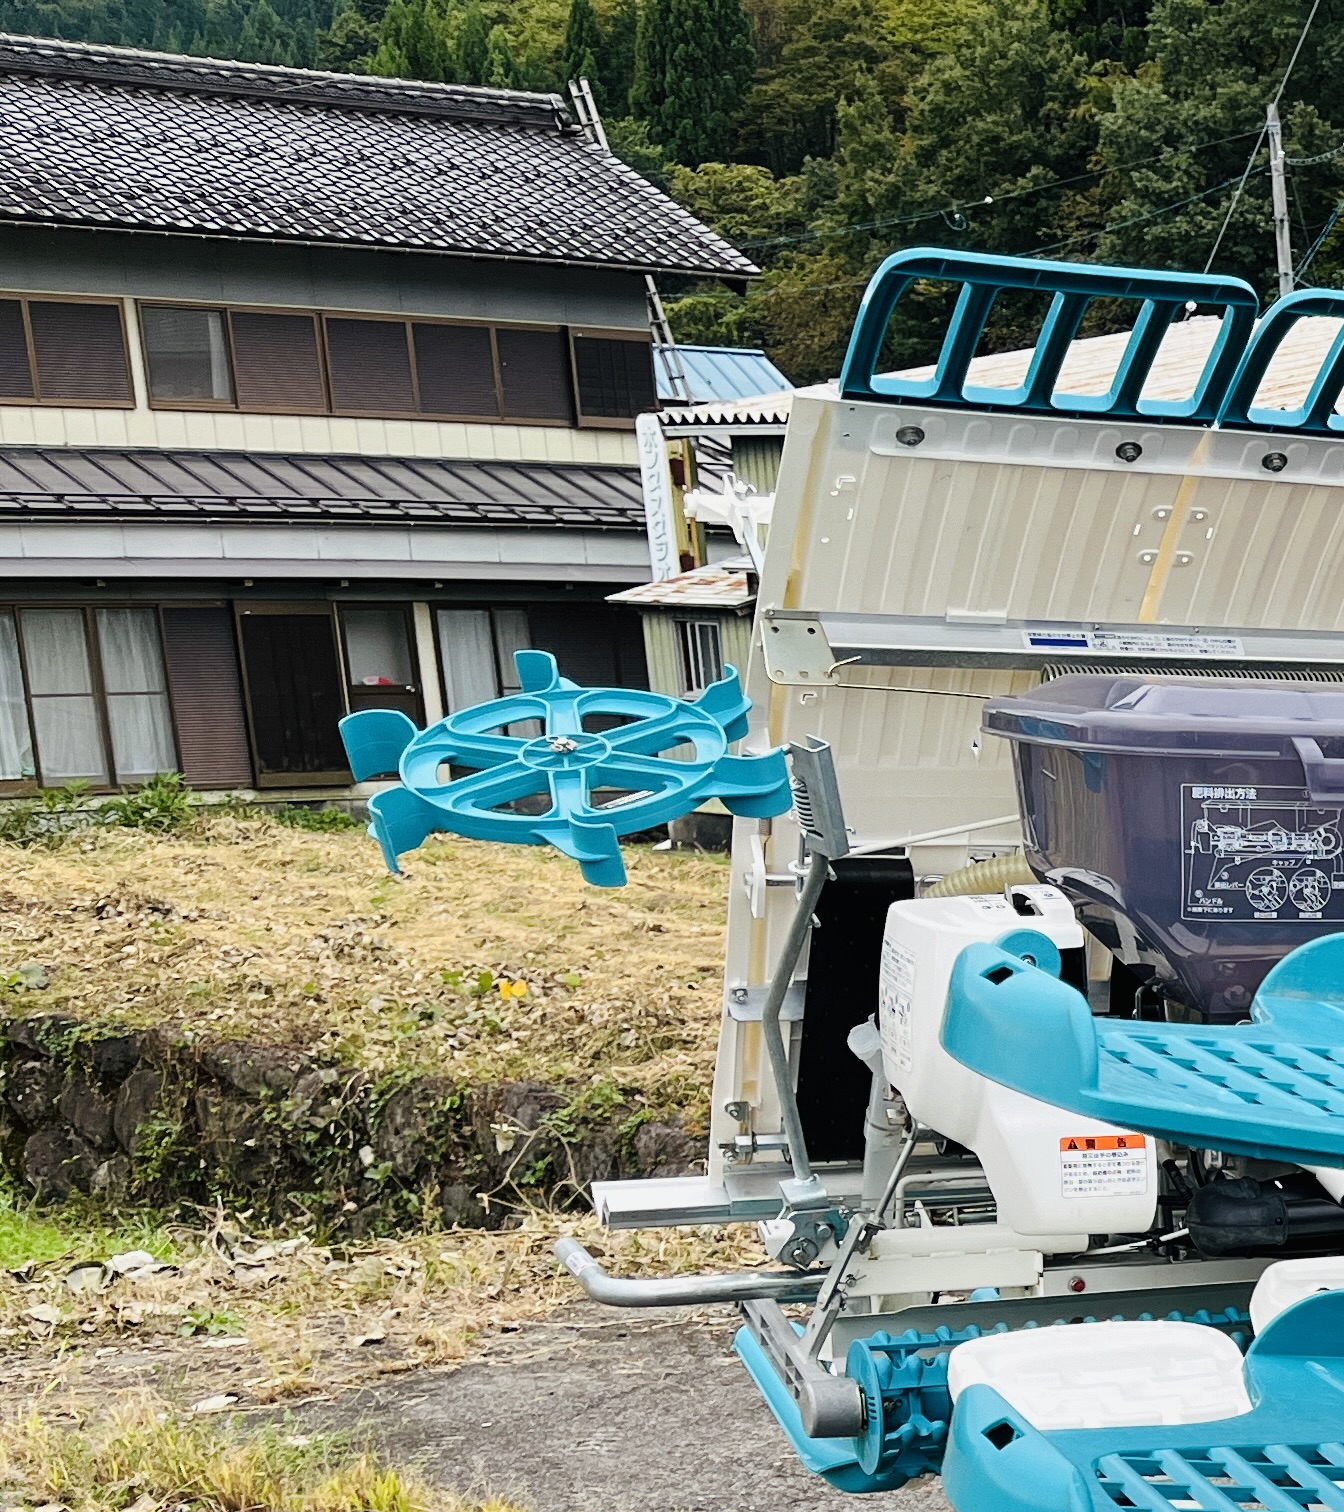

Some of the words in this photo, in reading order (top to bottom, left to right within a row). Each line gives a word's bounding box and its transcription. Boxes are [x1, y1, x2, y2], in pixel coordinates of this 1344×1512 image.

[1191, 787, 1257, 800] 肥料排出方法
